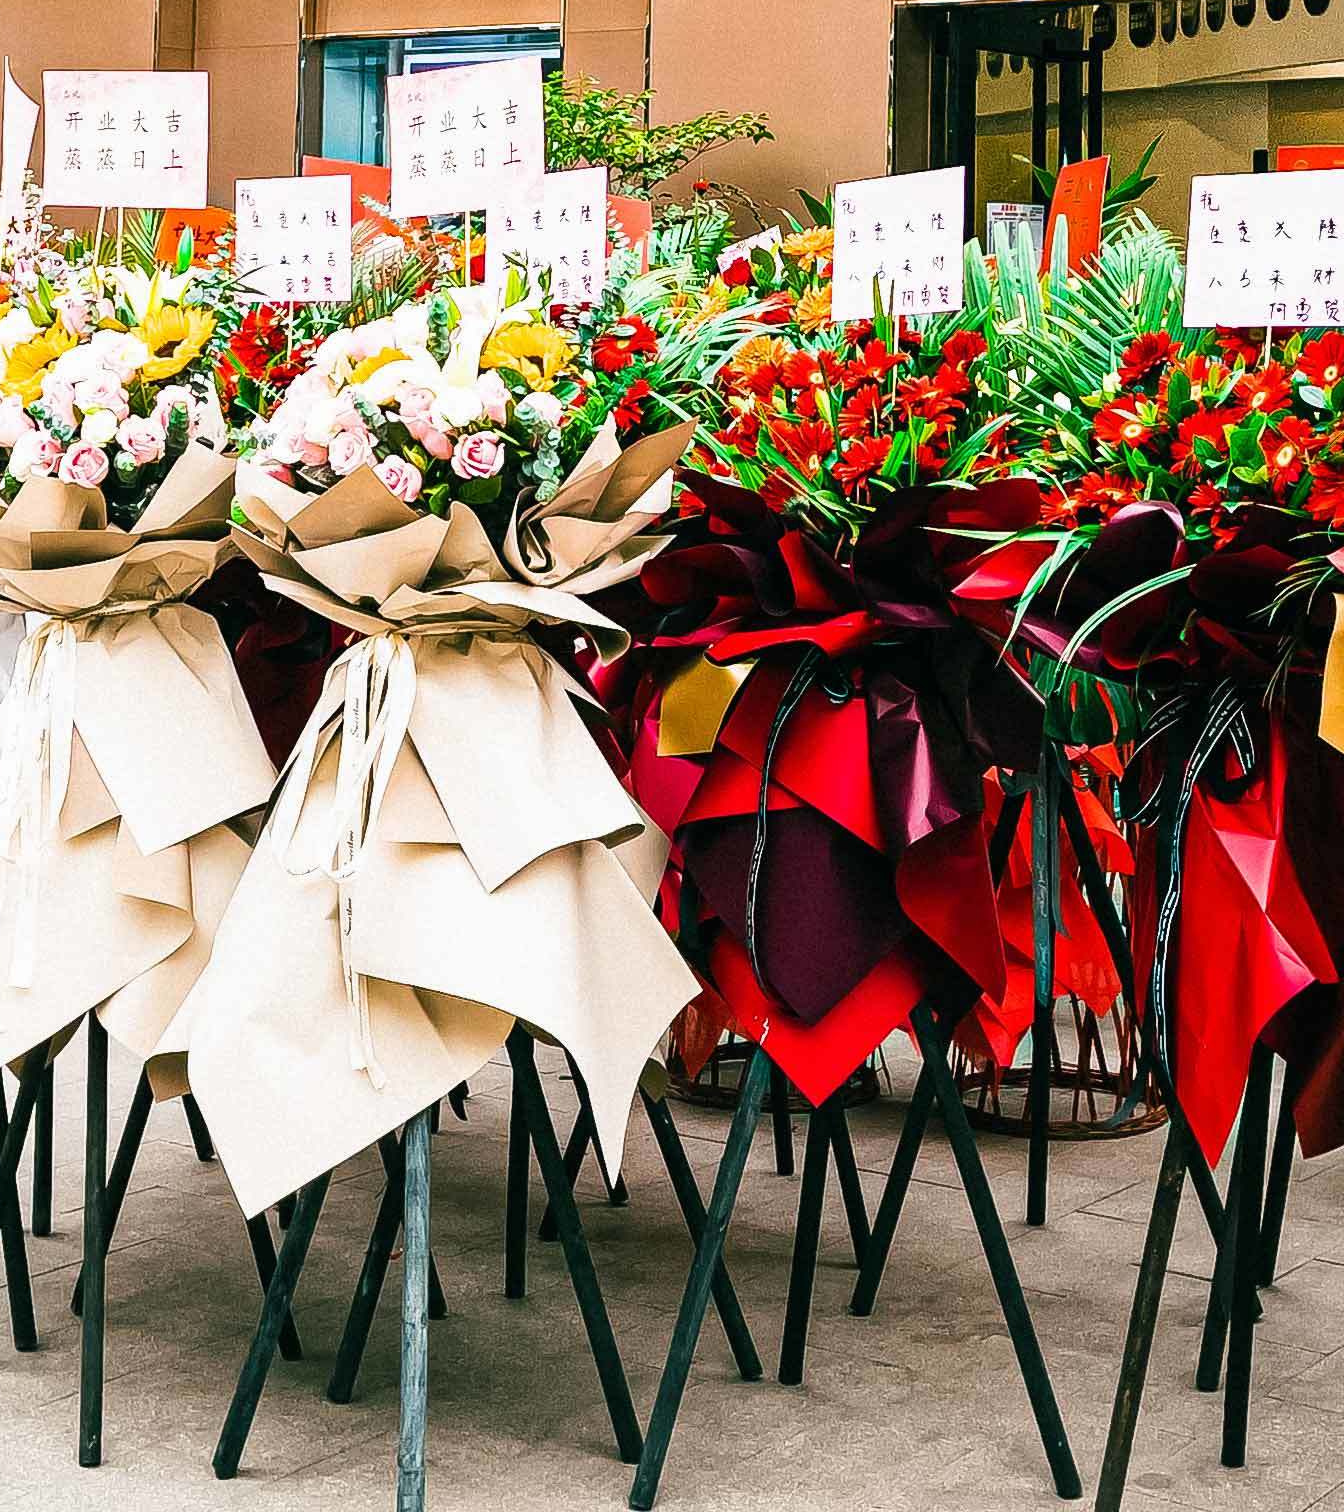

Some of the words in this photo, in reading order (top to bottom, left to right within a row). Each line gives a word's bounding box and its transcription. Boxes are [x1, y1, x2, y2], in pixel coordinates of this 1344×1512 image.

[65, 110, 183, 133] 开业大吉
[408, 99, 518, 137] 开业大吉
[63, 147, 184, 171] 蒸蒸日上
[409, 141, 522, 180] 蒸蒸日上
